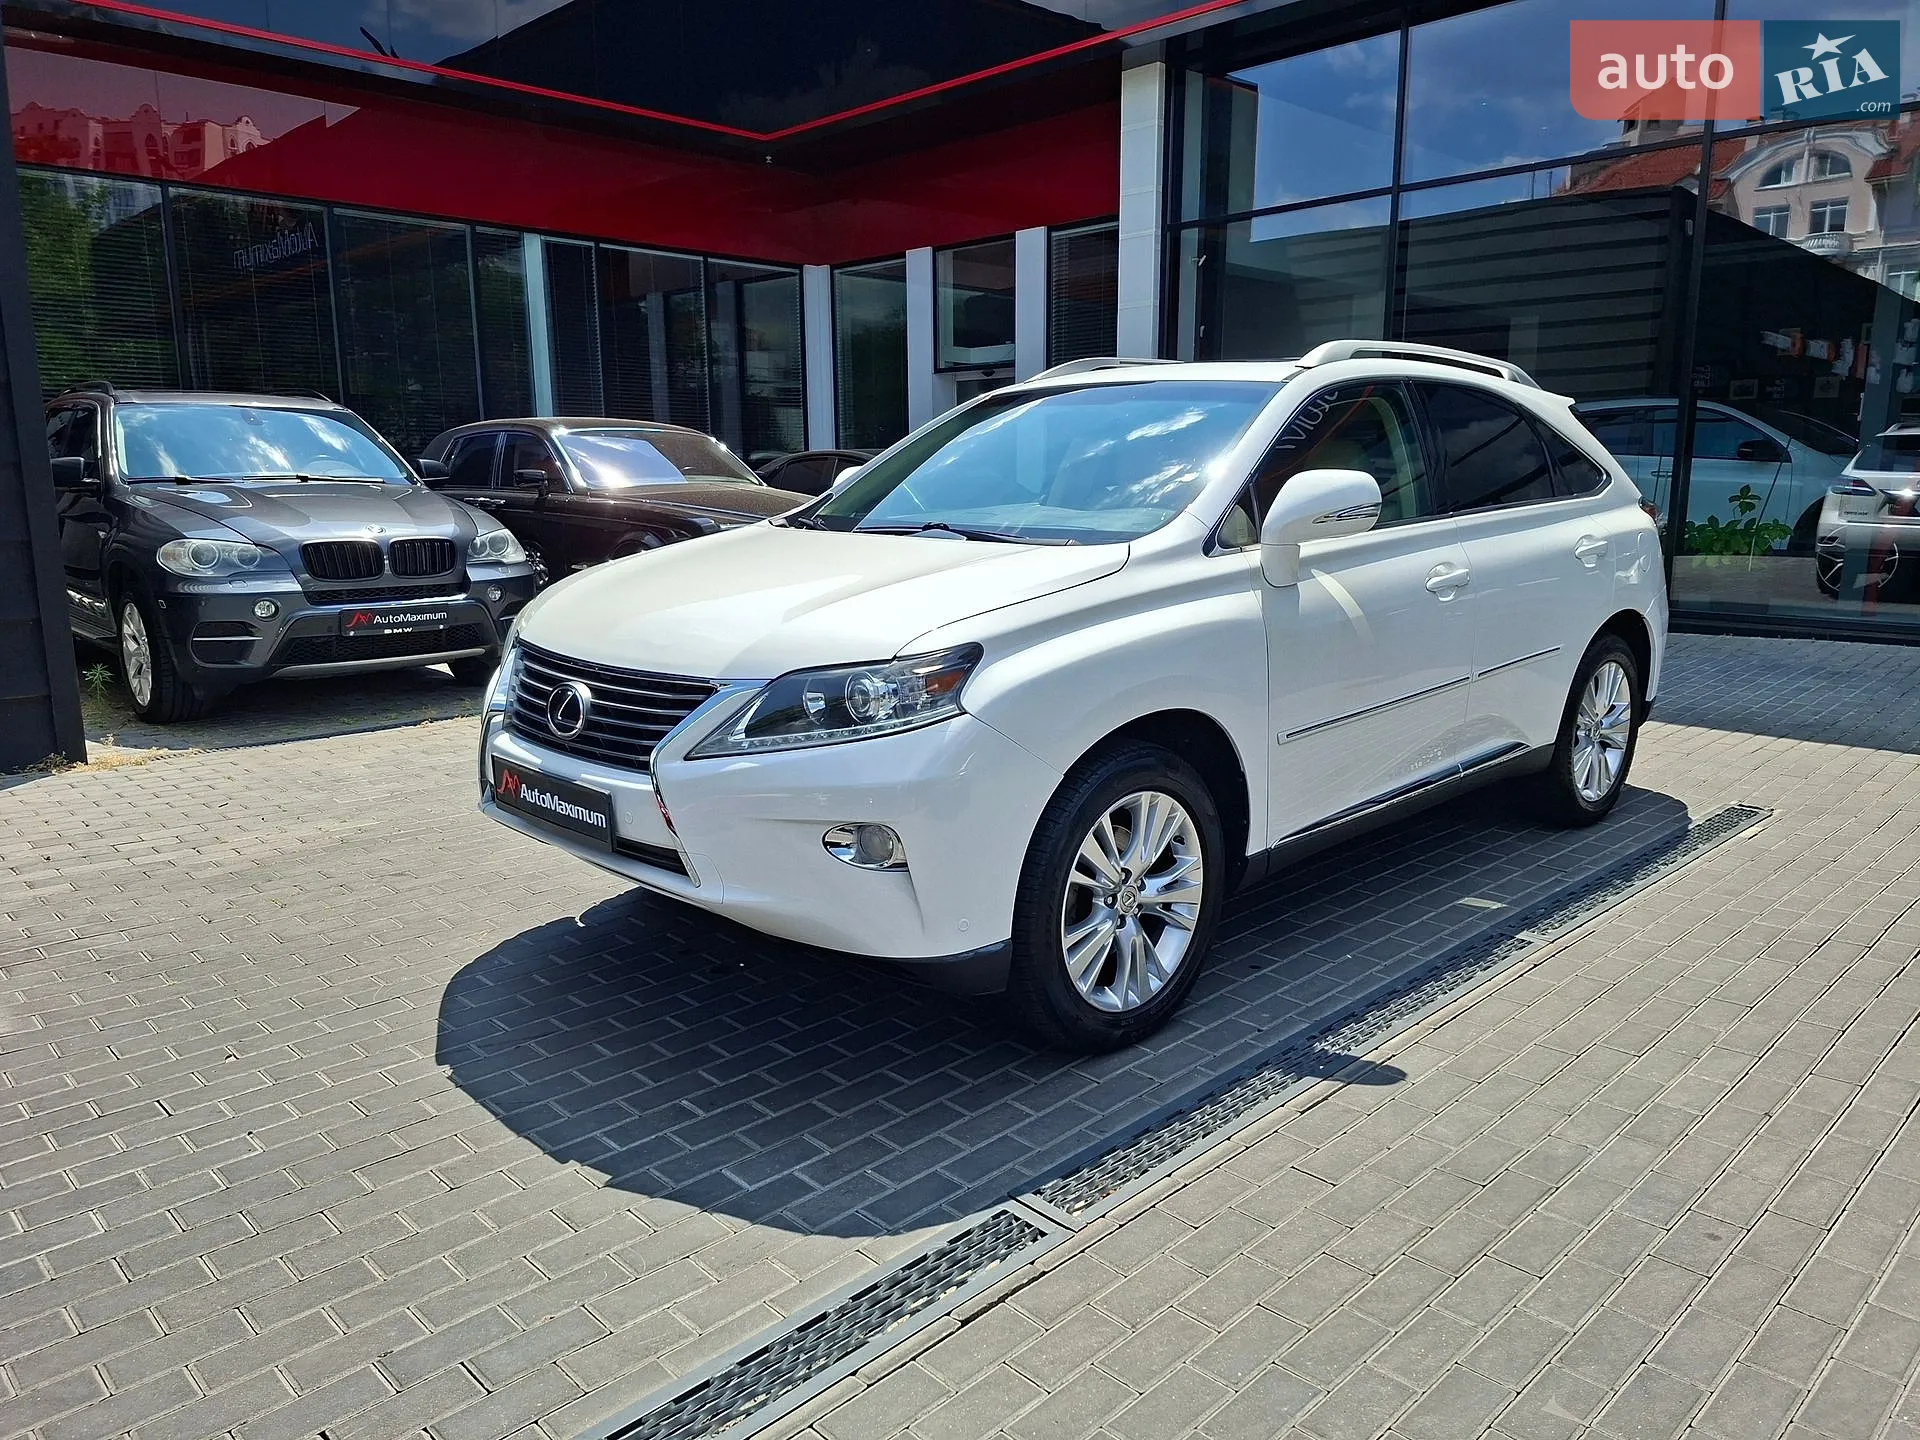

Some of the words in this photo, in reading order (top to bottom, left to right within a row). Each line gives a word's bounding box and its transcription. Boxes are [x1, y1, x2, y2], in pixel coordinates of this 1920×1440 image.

[373, 611, 448, 625] AutoMaximum
[383, 626, 413, 635] BMW
[520, 783, 607, 828] AutoMaximum
